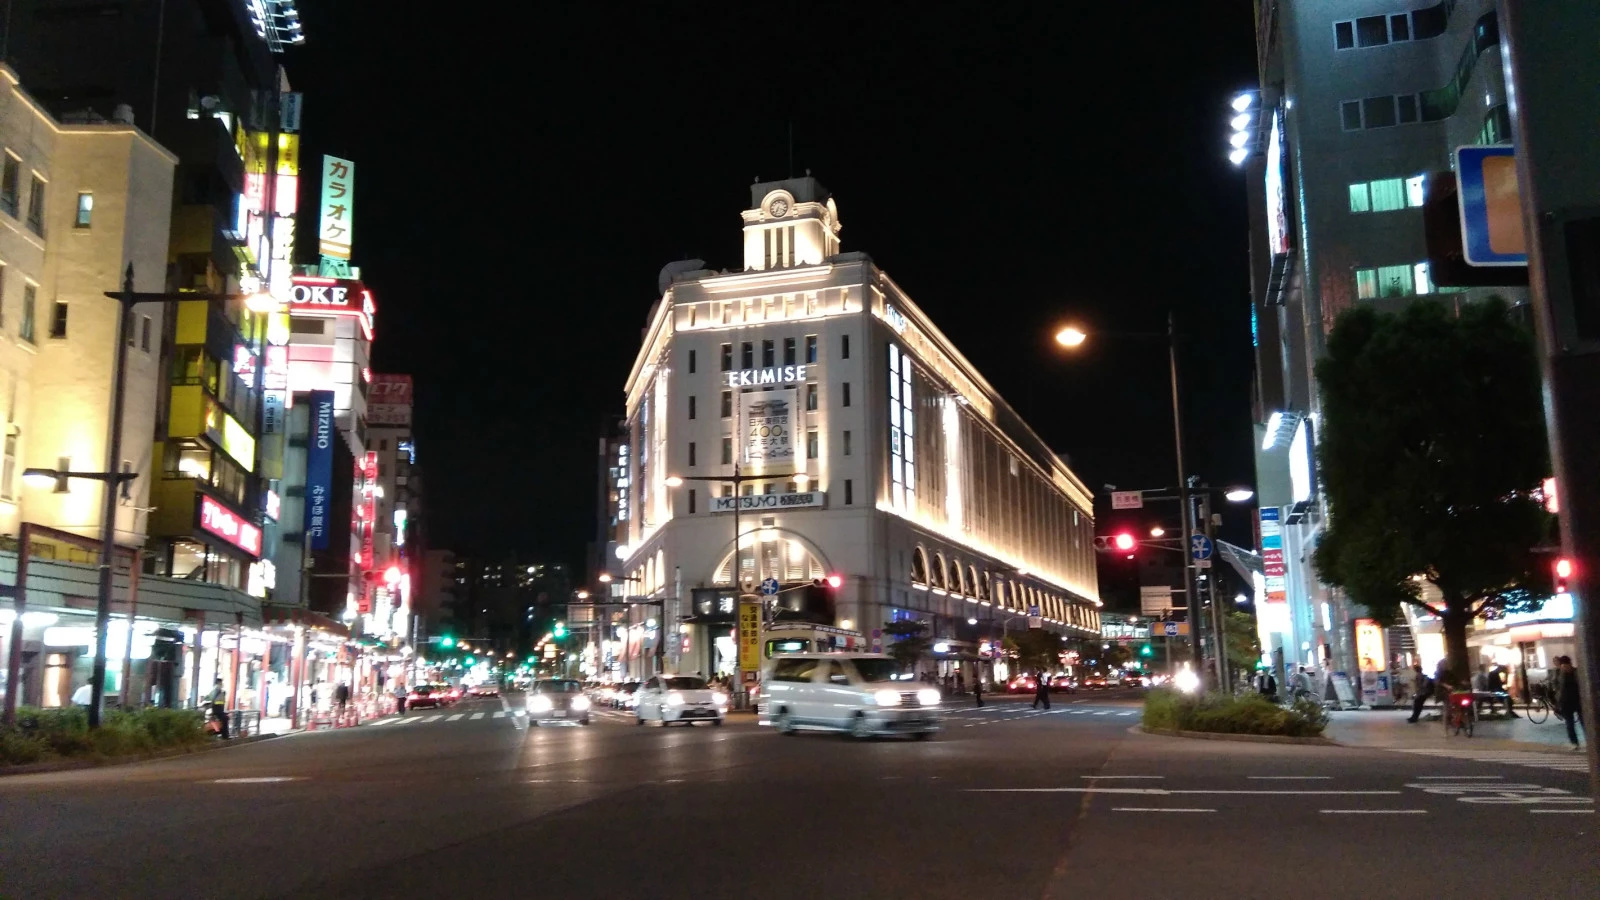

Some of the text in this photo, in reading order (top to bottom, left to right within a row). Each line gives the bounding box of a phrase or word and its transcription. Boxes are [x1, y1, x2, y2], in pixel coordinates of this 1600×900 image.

[326, 161, 348, 239] カラオケ
[729, 365, 807, 387] EKIMISE
[317, 401, 331, 449] MIZUHO
[617, 444, 628, 520] EKIMISE
[311, 485, 325, 537] みずほ銀行
